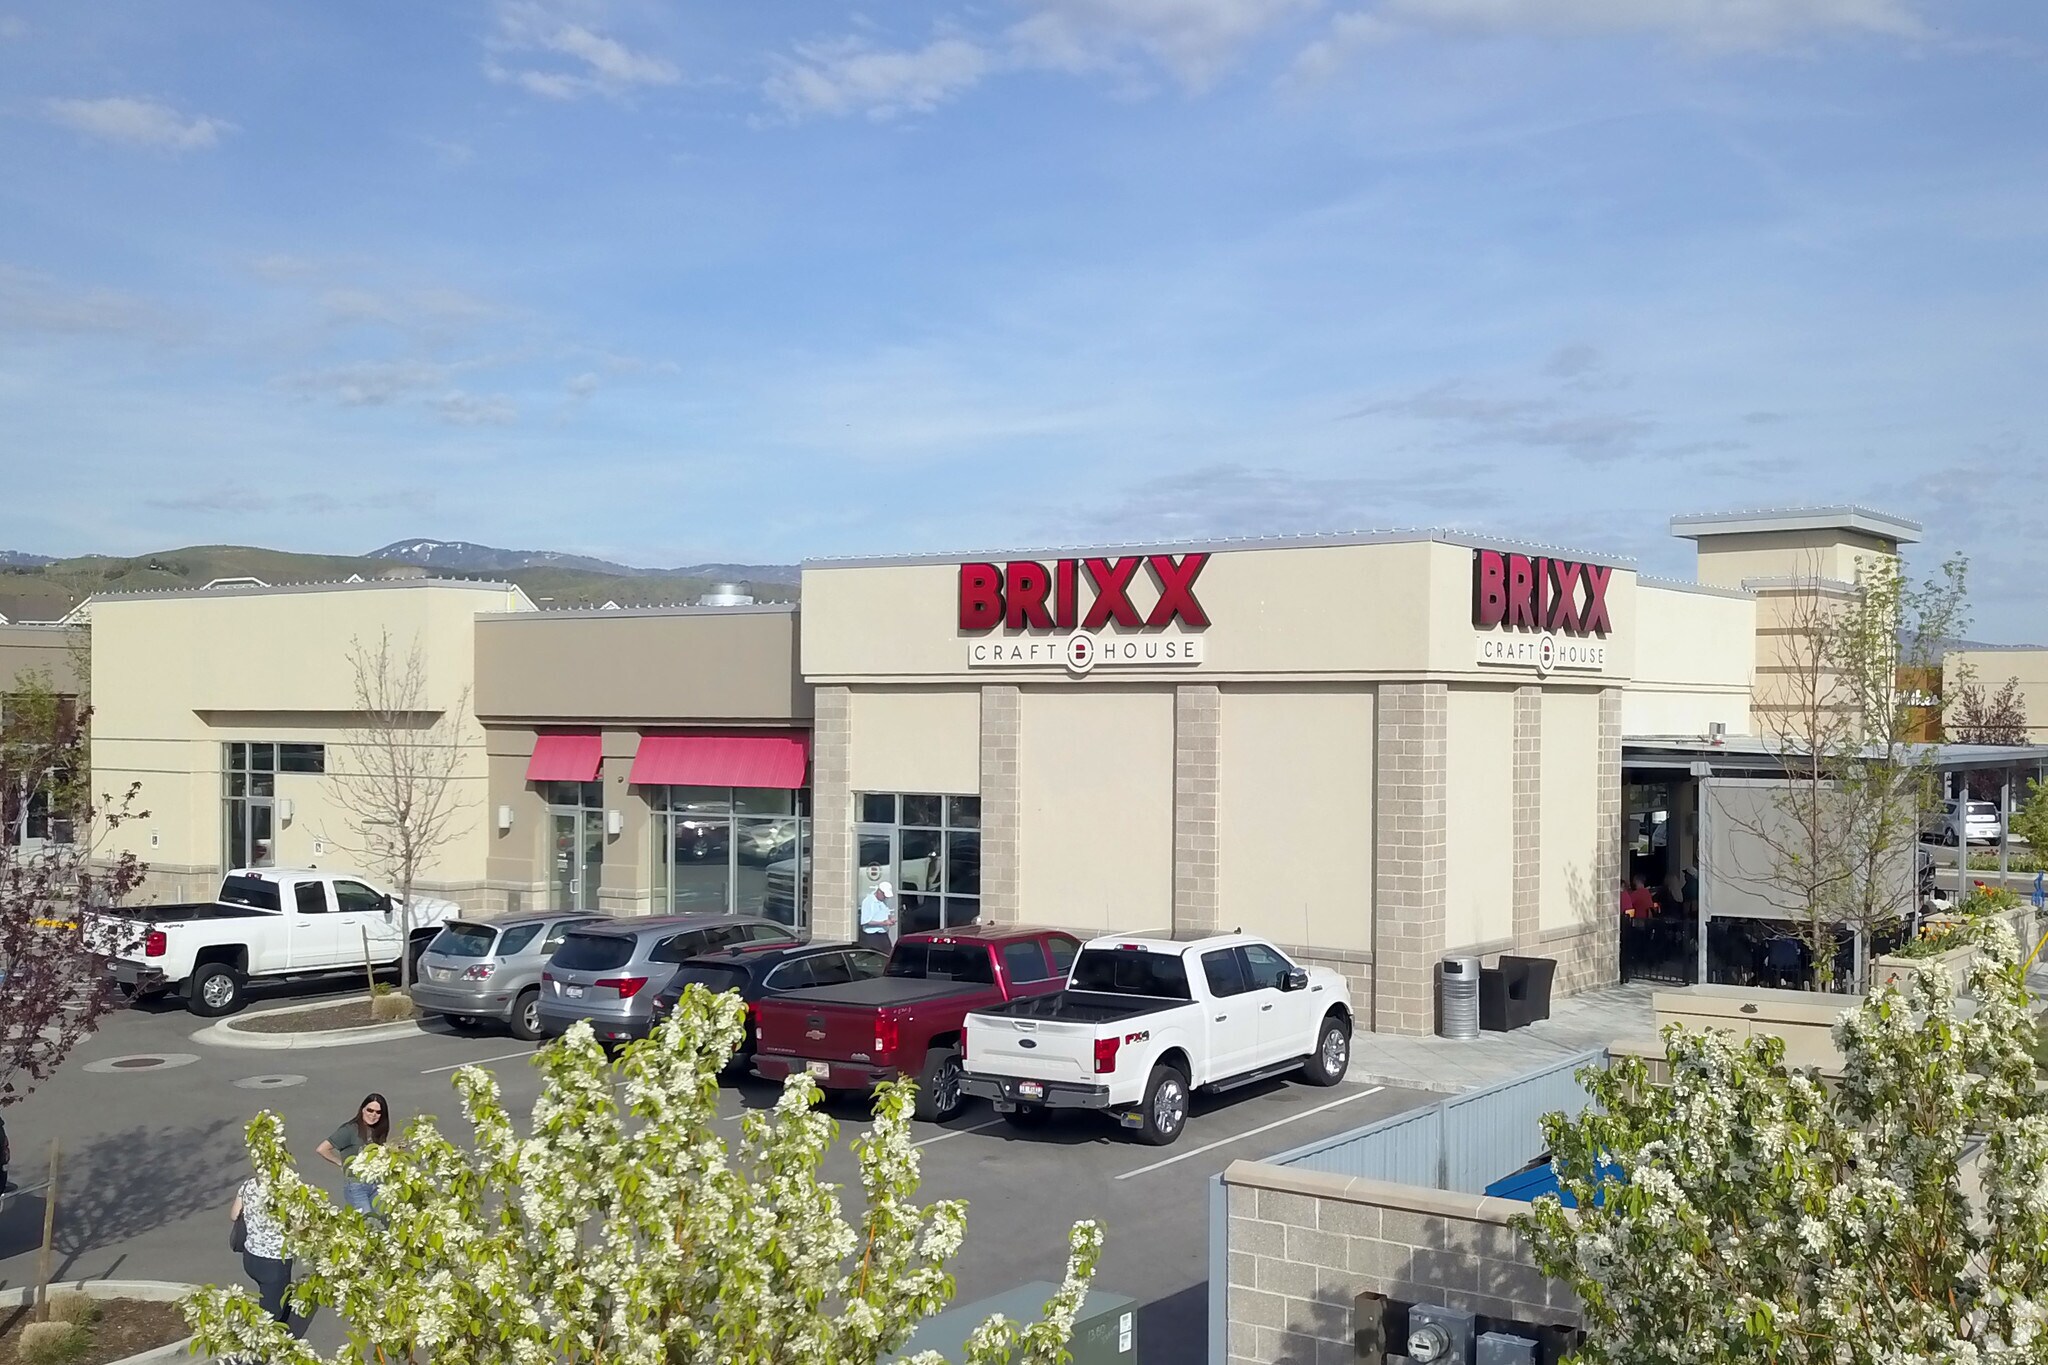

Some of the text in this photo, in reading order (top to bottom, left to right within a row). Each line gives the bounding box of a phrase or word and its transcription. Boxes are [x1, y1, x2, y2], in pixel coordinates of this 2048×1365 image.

[959, 552, 1212, 631] BRIXX
[1474, 549, 1613, 634] BRIXX
[974, 644, 1057, 661] CRAFT
[1104, 641, 1195, 660] HOUSE
[1484, 641, 1535, 660] CRAFT
[1559, 648, 1604, 664] HOUSE
[1125, 1030, 1150, 1045] FX4
